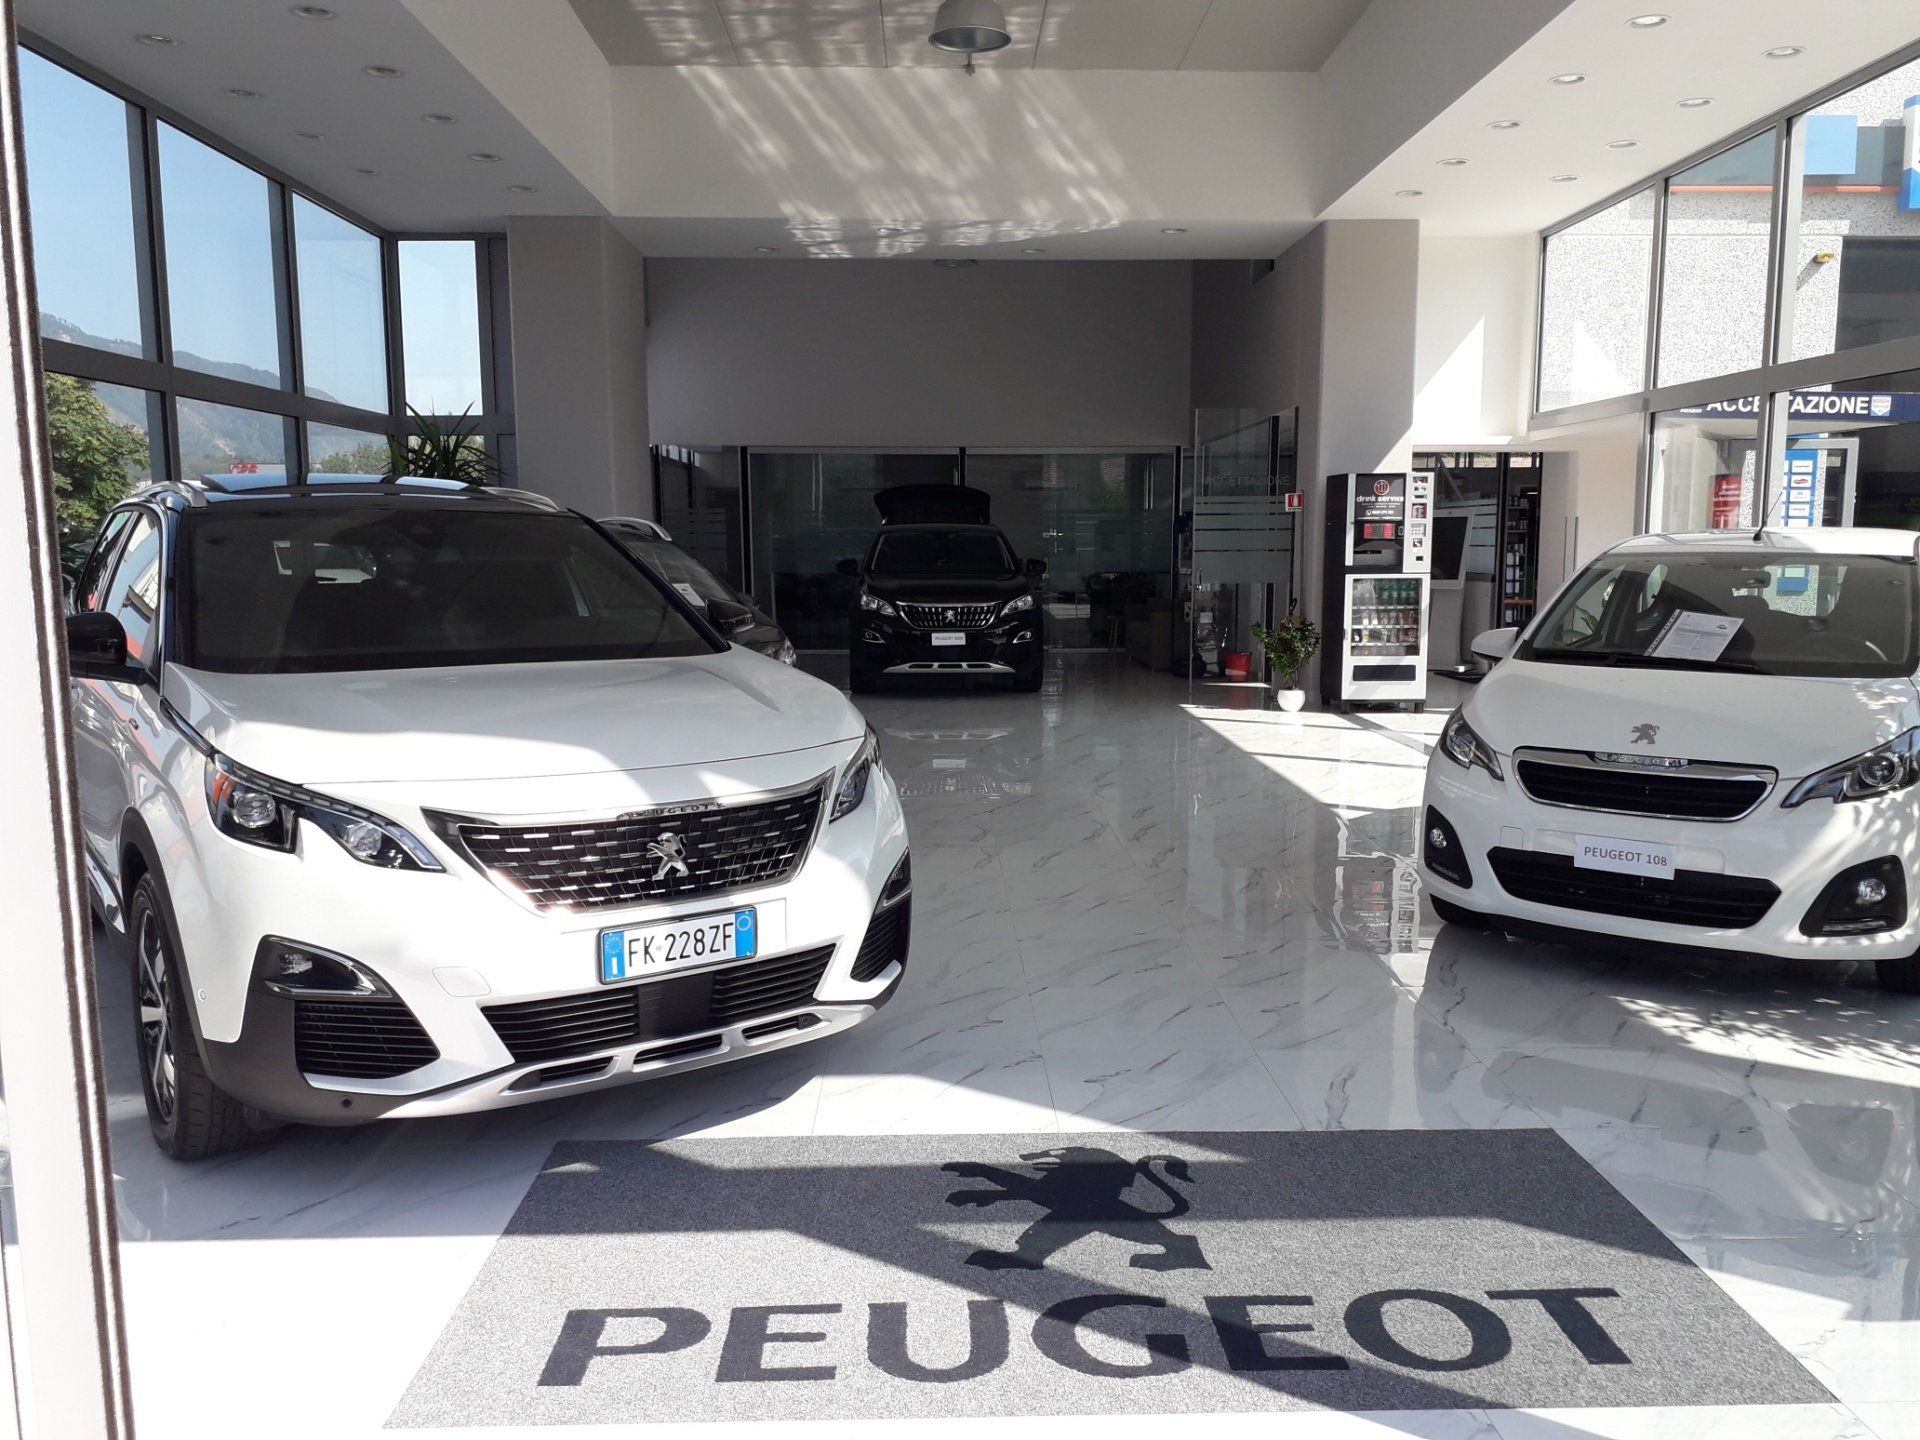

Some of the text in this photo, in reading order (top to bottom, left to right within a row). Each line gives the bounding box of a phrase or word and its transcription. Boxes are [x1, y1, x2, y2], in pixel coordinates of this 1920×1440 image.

[1584, 846, 1668, 867] PEUGEOT 108
[628, 922, 734, 967] FK 228ZF
[536, 1287, 1635, 1387] PEUGEOT
